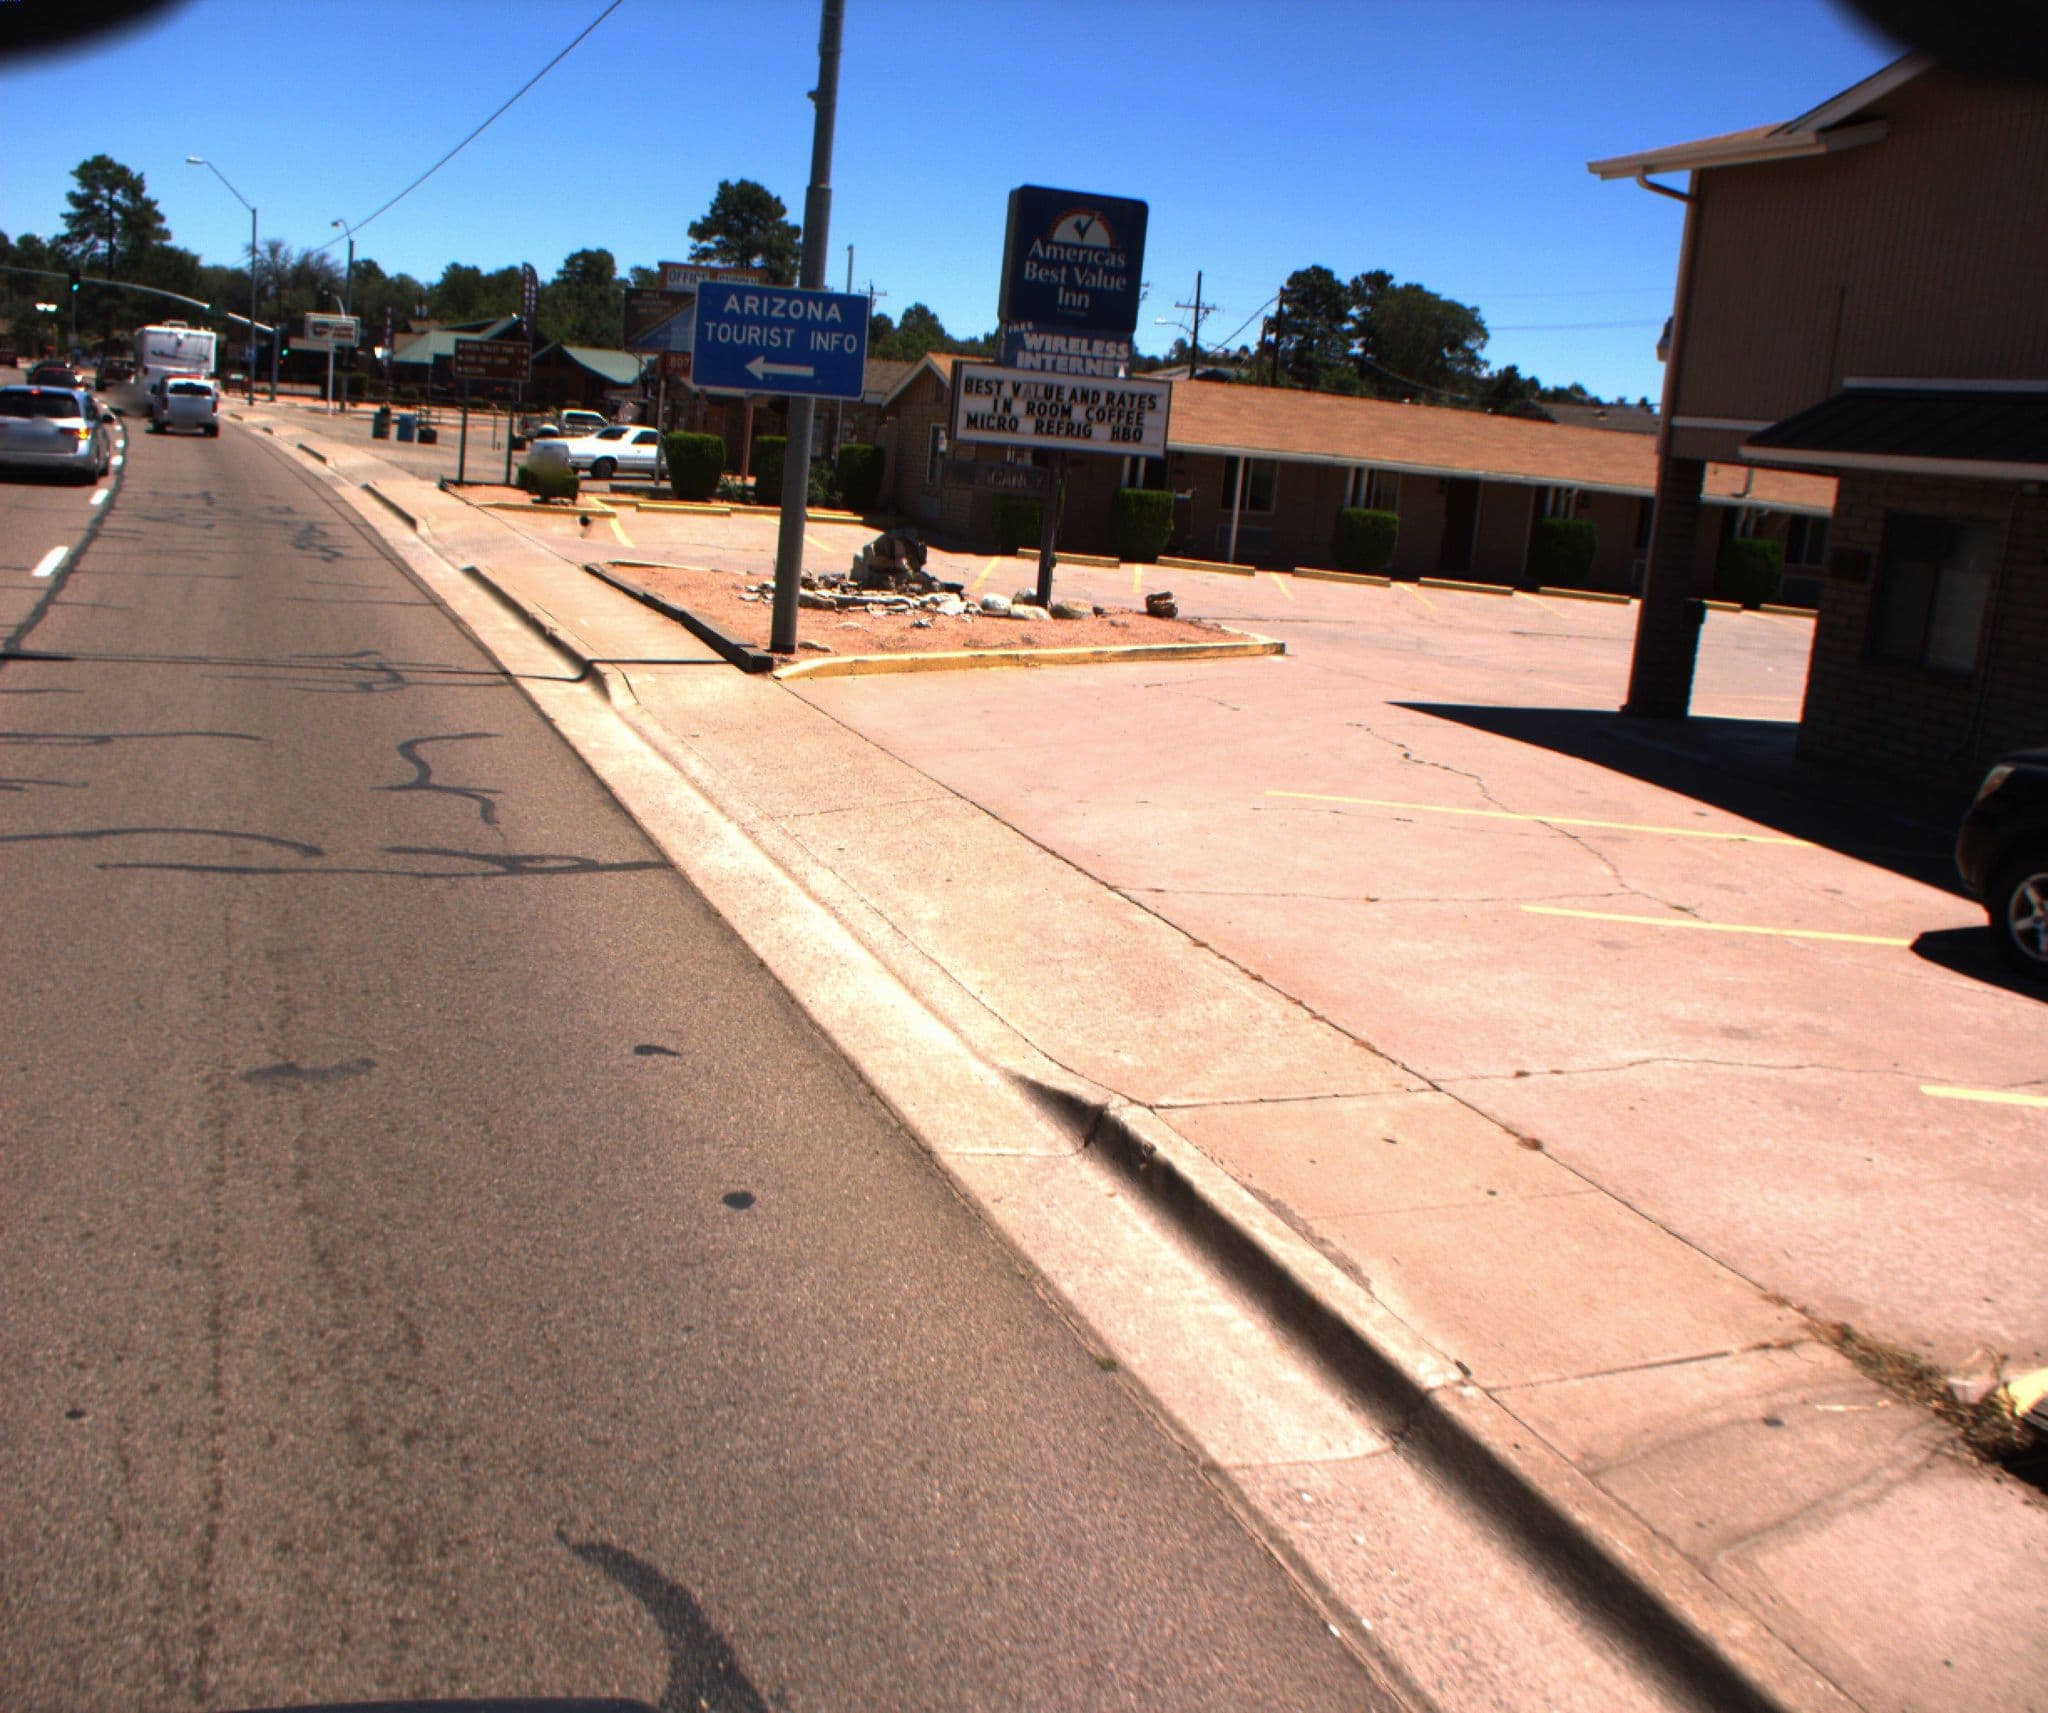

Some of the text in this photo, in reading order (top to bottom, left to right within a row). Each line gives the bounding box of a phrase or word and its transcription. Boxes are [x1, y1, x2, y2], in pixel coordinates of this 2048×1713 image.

[1028, 238, 1126, 267] Americas
[1024, 260, 1127, 291] Best Value
[723, 294, 842, 323] ARIZONA
[1058, 285, 1090, 308] Inn
[705, 322, 796, 350] TOURIST
[810, 330, 858, 354] INFO
[1024, 332, 1129, 360] WIRELESS
[1016, 350, 1130, 377] INTERNET
[965, 375, 1158, 410] BEST VALUE AND RATES
[993, 398, 1145, 426] IN ROOM COFFEE
[966, 411, 1144, 443] MICRO REFRIG HBO
